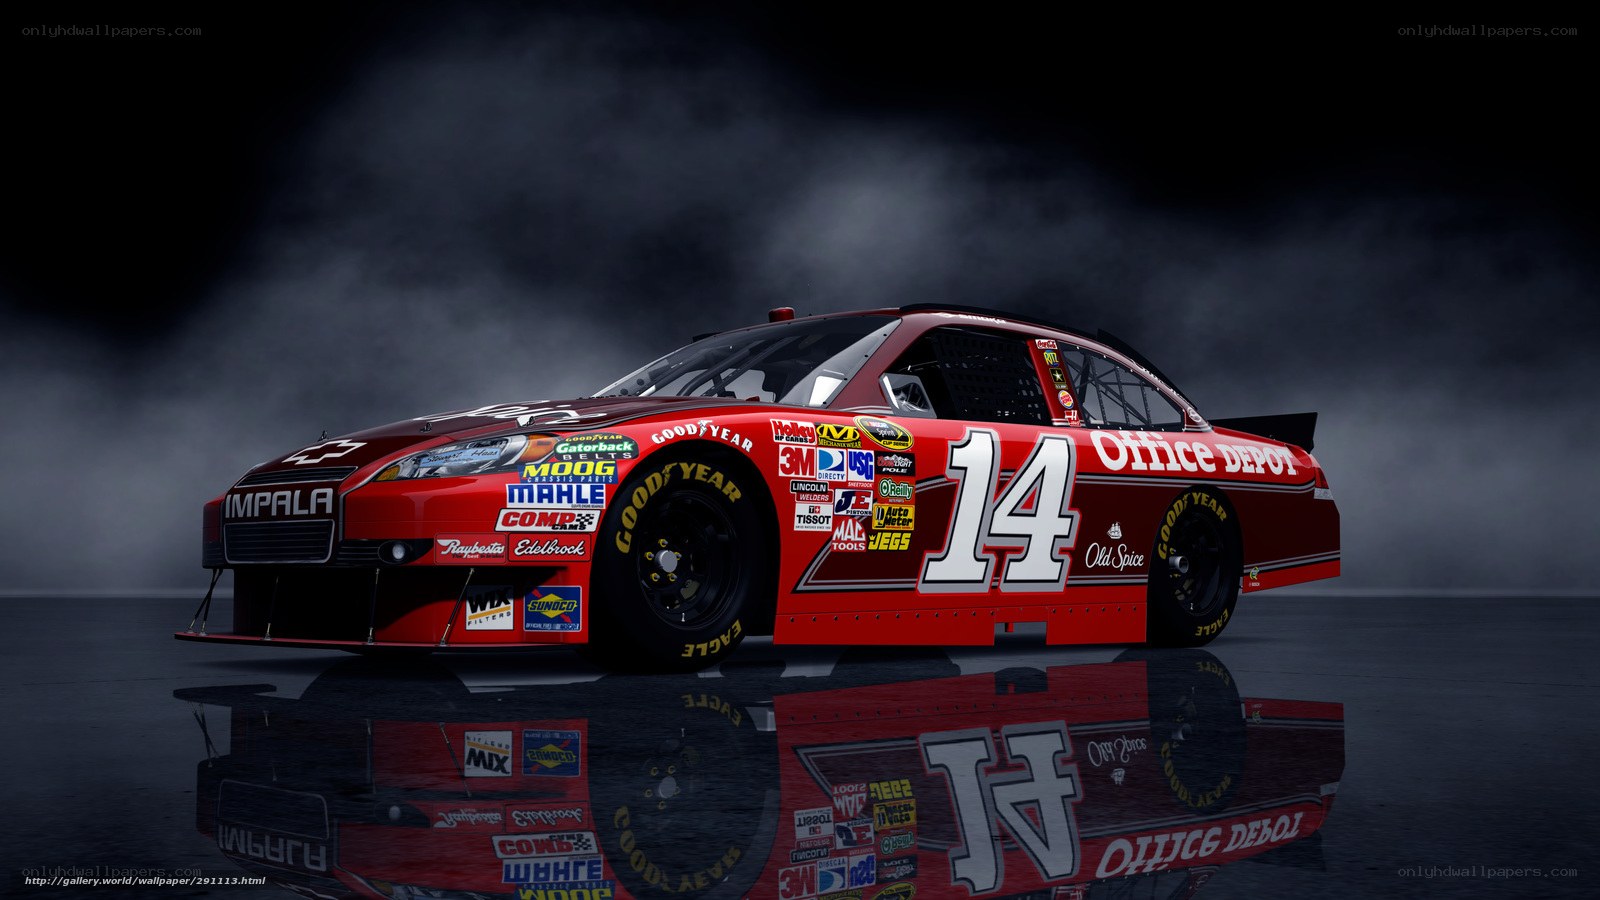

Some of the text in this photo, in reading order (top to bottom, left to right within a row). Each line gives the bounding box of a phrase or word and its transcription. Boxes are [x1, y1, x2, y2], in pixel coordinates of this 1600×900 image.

[772, 420, 814, 443] Holley
[556, 441, 634, 453] Gatorback
[563, 452, 632, 460] BELTS
[1090, 430, 1297, 476] Office DEPOT
[522, 461, 616, 478] MOOG
[780, 447, 815, 476] 3M
[848, 451, 874, 480] USG
[527, 475, 613, 483] CHASSIS PARTS
[818, 472, 846, 480] DIRECTV
[508, 484, 605, 504] MAHLE
[792, 482, 827, 492] LINCOLN
[880, 479, 914, 499] O'Reilly
[225, 488, 333, 519] IMPALA
[800, 493, 830, 502] WELDERS
[835, 490, 872, 513] JE
[886, 506, 909, 516] Auto
[918, 427, 1079, 592] 14
[501, 511, 576, 527] COMP
[551, 523, 587, 531] CAMS
[796, 514, 832, 525] TISSOT
[883, 516, 913, 527] Meter
[832, 519, 867, 541] MAC
[514, 538, 585, 556] Edelbrock
[832, 542, 866, 551] TOOLS
[868, 532, 912, 551] JEGS
[1085, 542, 1144, 571] Old Spice
[468, 586, 511, 614] WIX
[528, 600, 576, 611] SUNOCO
[467, 611, 512, 626] FILTERS
[1195, 608, 1229, 636] EAGLE
[681, 619, 742, 658] EAGLE
